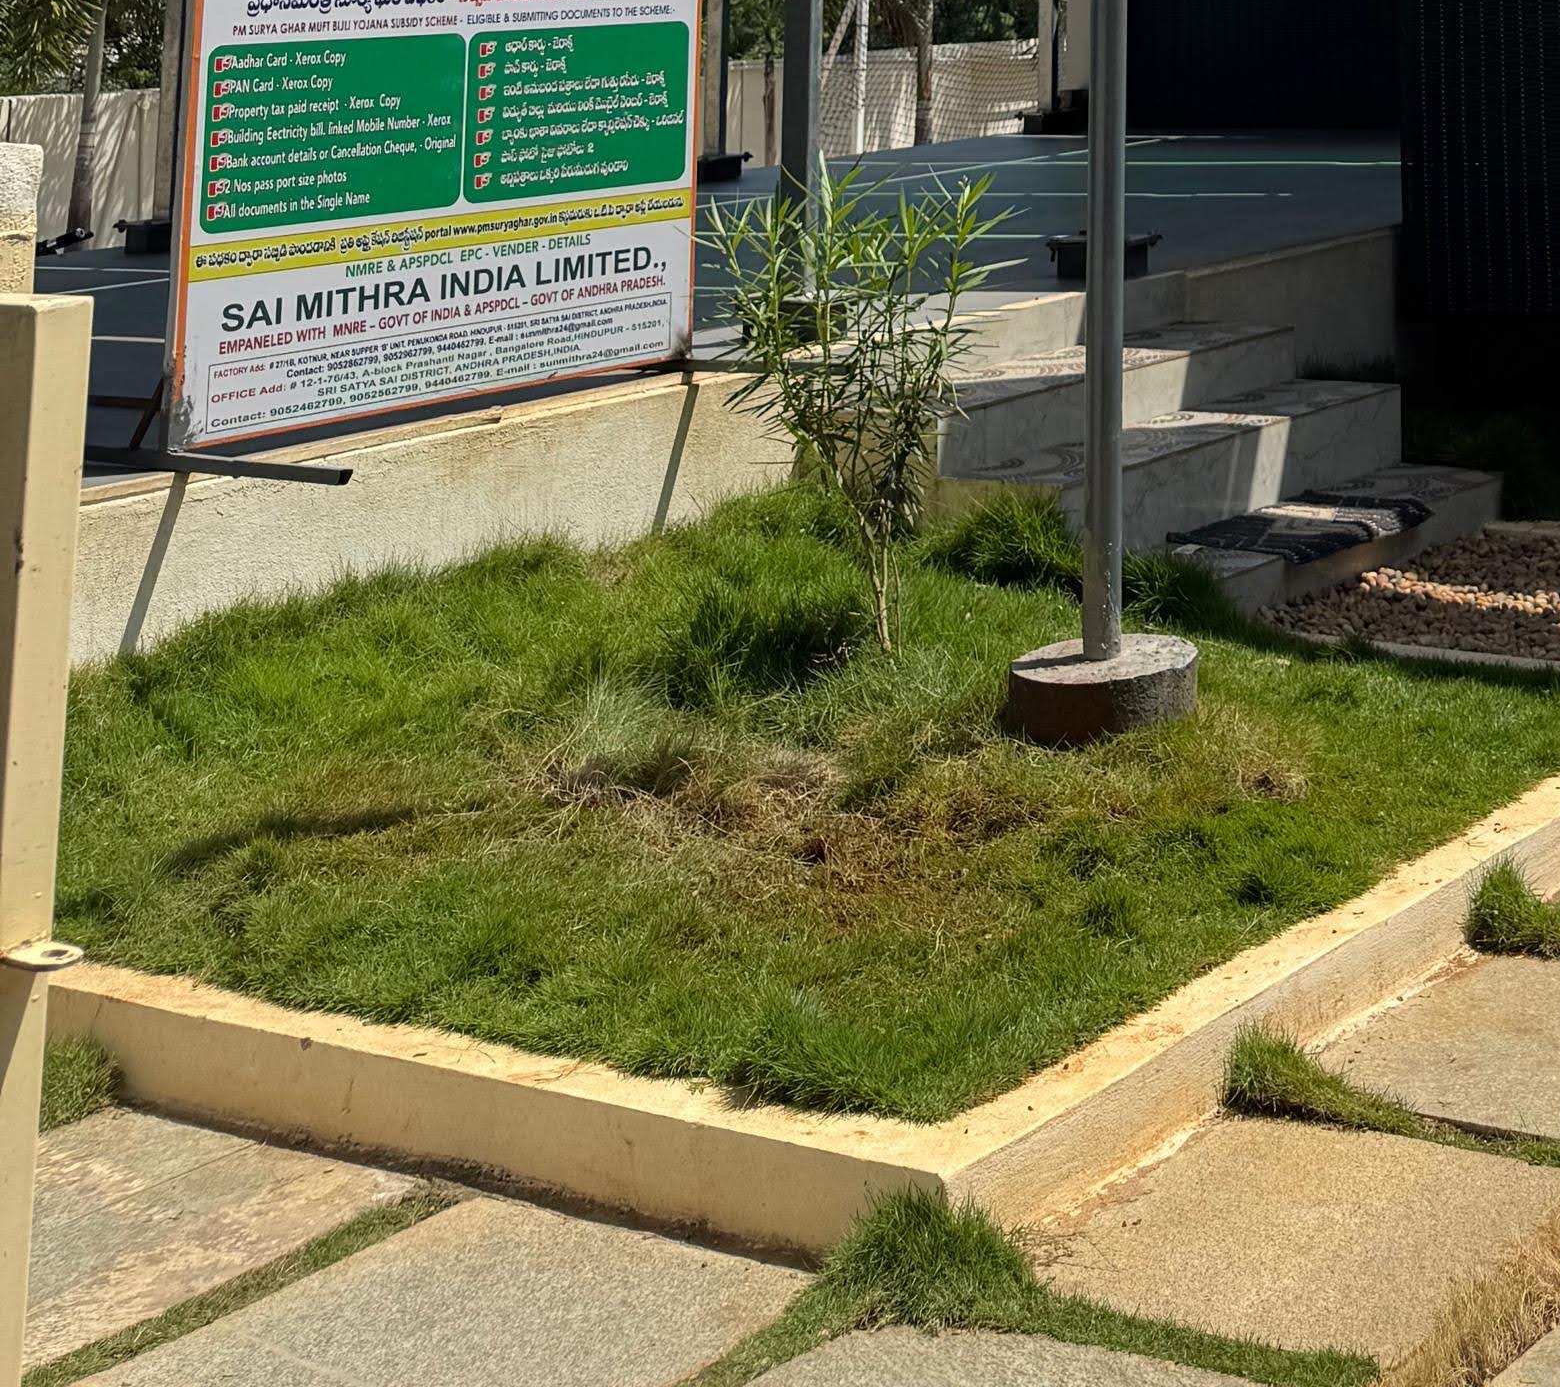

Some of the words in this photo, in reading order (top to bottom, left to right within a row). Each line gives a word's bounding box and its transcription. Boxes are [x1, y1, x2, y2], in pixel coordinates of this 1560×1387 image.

[231, 24, 247, 36] PM
[248, 23, 277, 35] SURYA
[279, 21, 306, 34] GHAR
[307, 20, 330, 32] MUFT
[331, 19, 351, 32] BIJLI
[352, 18, 388, 30] YOJANA
[390, 16, 423, 29] SUBSIDY
[424, 14, 457, 27] SCHEME
[466, 12, 501, 25] ELIGIBLE
[503, 12, 510, 23] &
[511, 9, 559, 23] SUBMITTING
[560, 7, 610, 20] DOCUMENTS
[611, 6, 623, 17] TO
[624, 5, 638, 16] THE
[229, 53, 264, 69] Aadhar
[265, 51, 287, 67] Card
[294, 51, 321, 65] Xerox
[323, 49, 346, 67] Copy
[228, 78, 250, 93] PAN
[252, 76, 274, 92] Card
[281, 75, 308, 90] Xerox
[310, 74, 333, 91] Copy
[227, 103, 269, 121] Property
[270, 103, 285, 115] tax
[287, 98, 307, 118] paid
[308, 97, 339, 114] receipt
[348, 95, 374, 109] Xerox
[378, 92, 401, 110] Copy
[226, 127, 264, 145] Building
[266, 124, 308, 141] Eectricity
[224, 152, 248, 169] Bank
[250, 151, 286, 166] account
[287, 146, 317, 163] details
[318, 149, 329, 160] or
[330, 141, 382, 159] Cancellation
[423, 133, 456, 153] Original
[223, 178, 231, 194] 2
[232, 178, 251, 192] Nos
[253, 178, 274, 194] pass
[275, 175, 296, 192] port
[297, 171, 315, 186] size
[316, 169, 347, 187] photos
[221, 202, 236, 218] All
[237, 200, 287, 217] documents
[289, 197, 298, 211] in
[299, 195, 315, 210] the
[316, 192, 343, 211] Single
[344, 191, 370, 205] Name
[423, 224, 453, 242] portal
[451, 211, 558, 237] www.pmsuryaghar.gov.in
[345, 260, 383, 277] NMRE
[386, 258, 396, 272] &
[398, 251, 453, 270] APSPDCL
[459, 246, 482, 262] EPC
[492, 240, 539, 257] VENDER
[547, 232, 591, 250] DETAILS
[221, 297, 282, 332] SAI
[295, 277, 430, 321] MITHRA
[440, 264, 526, 300] INDIA
[535, 246, 666, 285] LIMITED.,
[218, 331, 293, 355] EMPANELED
[295, 325, 326, 342] WITH
[332, 319, 366, 337] MNRE
[377, 312, 410, 330] GOVT
[411, 309, 428, 325] OF
[430, 305, 461, 322] INDIA
[463, 303, 471, 317] &
[473, 296, 520, 315] APSPDCL
[529, 290, 559, 306] GOVT
[560, 287, 575, 301] OF
[576, 281, 618, 299] ANDHRA
[620, 274, 665, 292] PRADESH.
[210, 387, 256, 403] OFFICE
[361, 363, 402, 377] A-block
[405, 353, 454, 369] Prashanti
[494, 340, 545, 355] Bangalore
[453, 357, 500, 372] ANDHRA
[210, 411, 266, 427] Contact:
